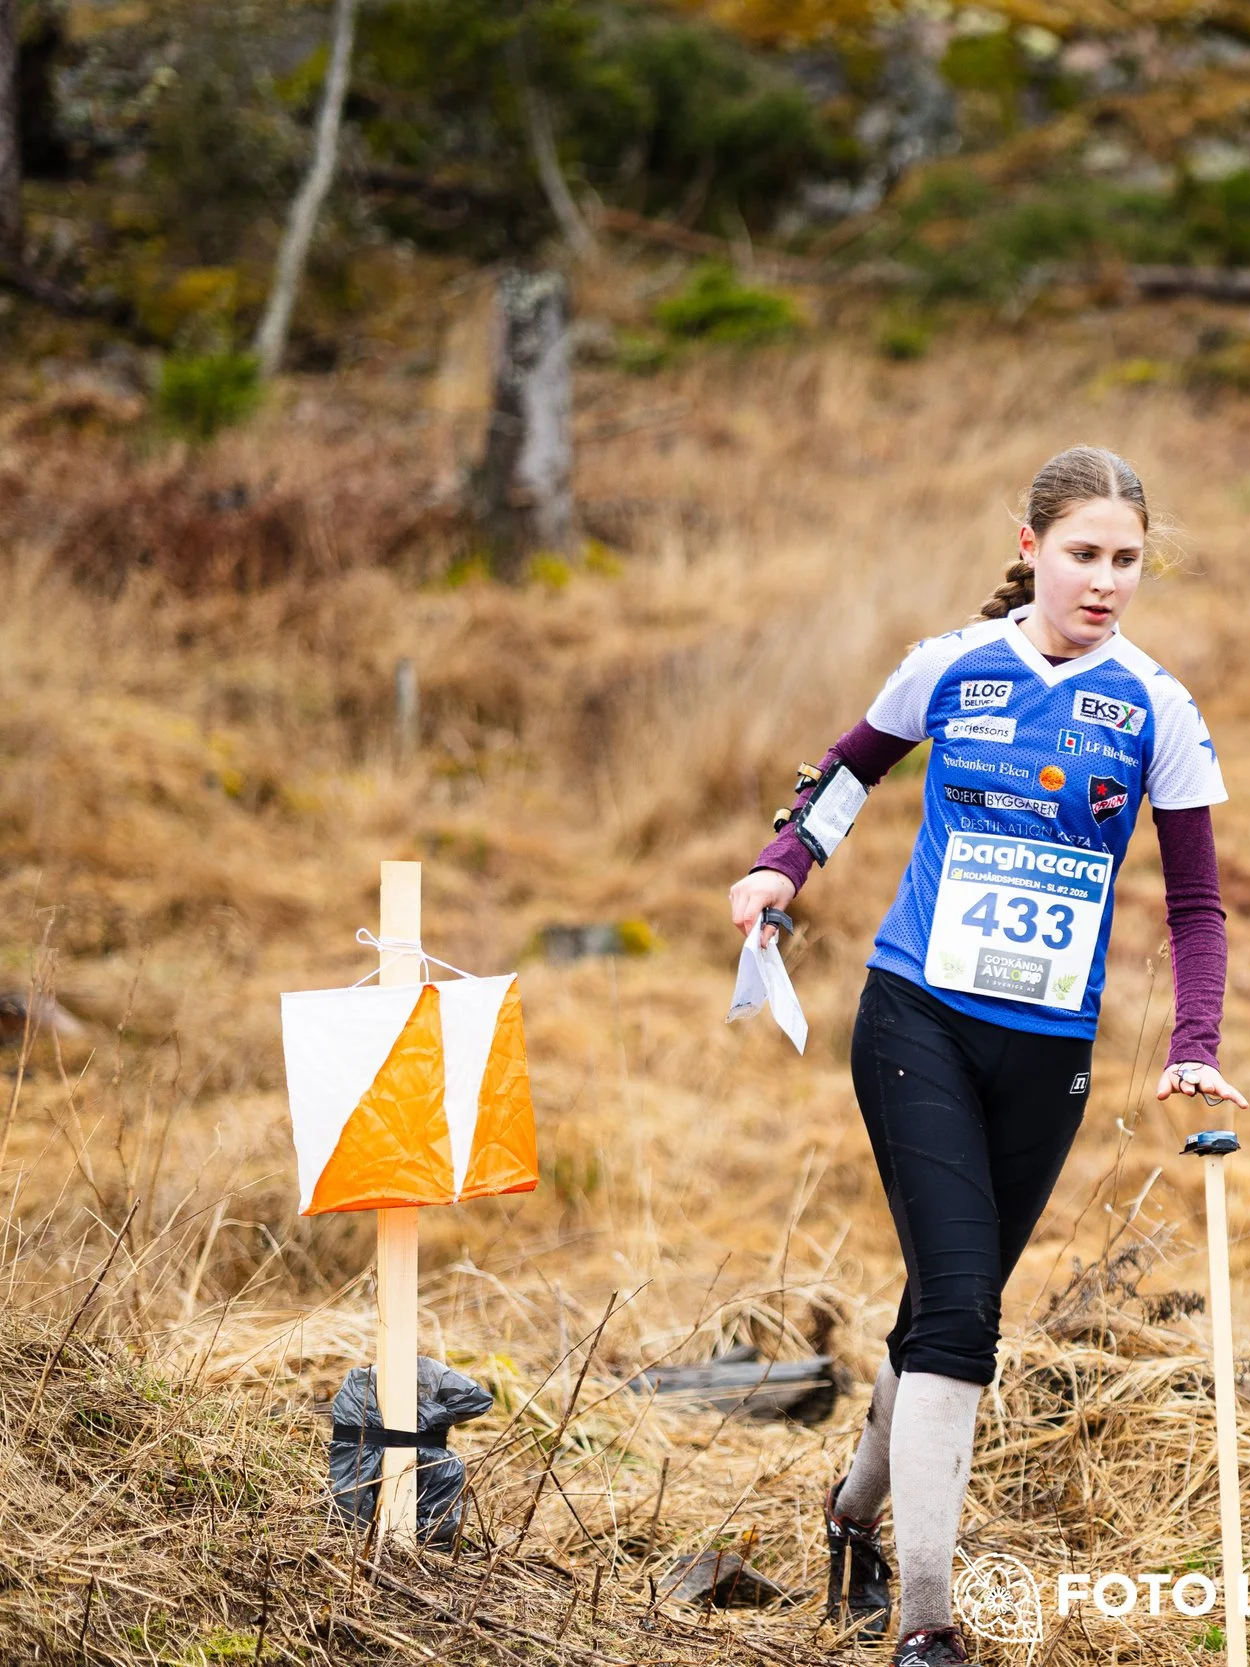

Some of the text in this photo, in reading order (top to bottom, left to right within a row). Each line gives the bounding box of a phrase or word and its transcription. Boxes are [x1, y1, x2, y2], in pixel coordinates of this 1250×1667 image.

[965, 683, 1008, 698] iLOG
[1085, 740, 1102, 754] LF
[999, 761, 1030, 779] Eken
[951, 837, 1107, 883] bagheera
[963, 872, 1041, 889] KOLMÅRDSMEDELN
[1047, 883, 1057, 893] SL
[1056, 885, 1069, 895] #2
[1069, 887, 1089, 899] 2026
[961, 891, 1075, 950] 433
[984, 954, 1044, 974] GODKÄNDA
